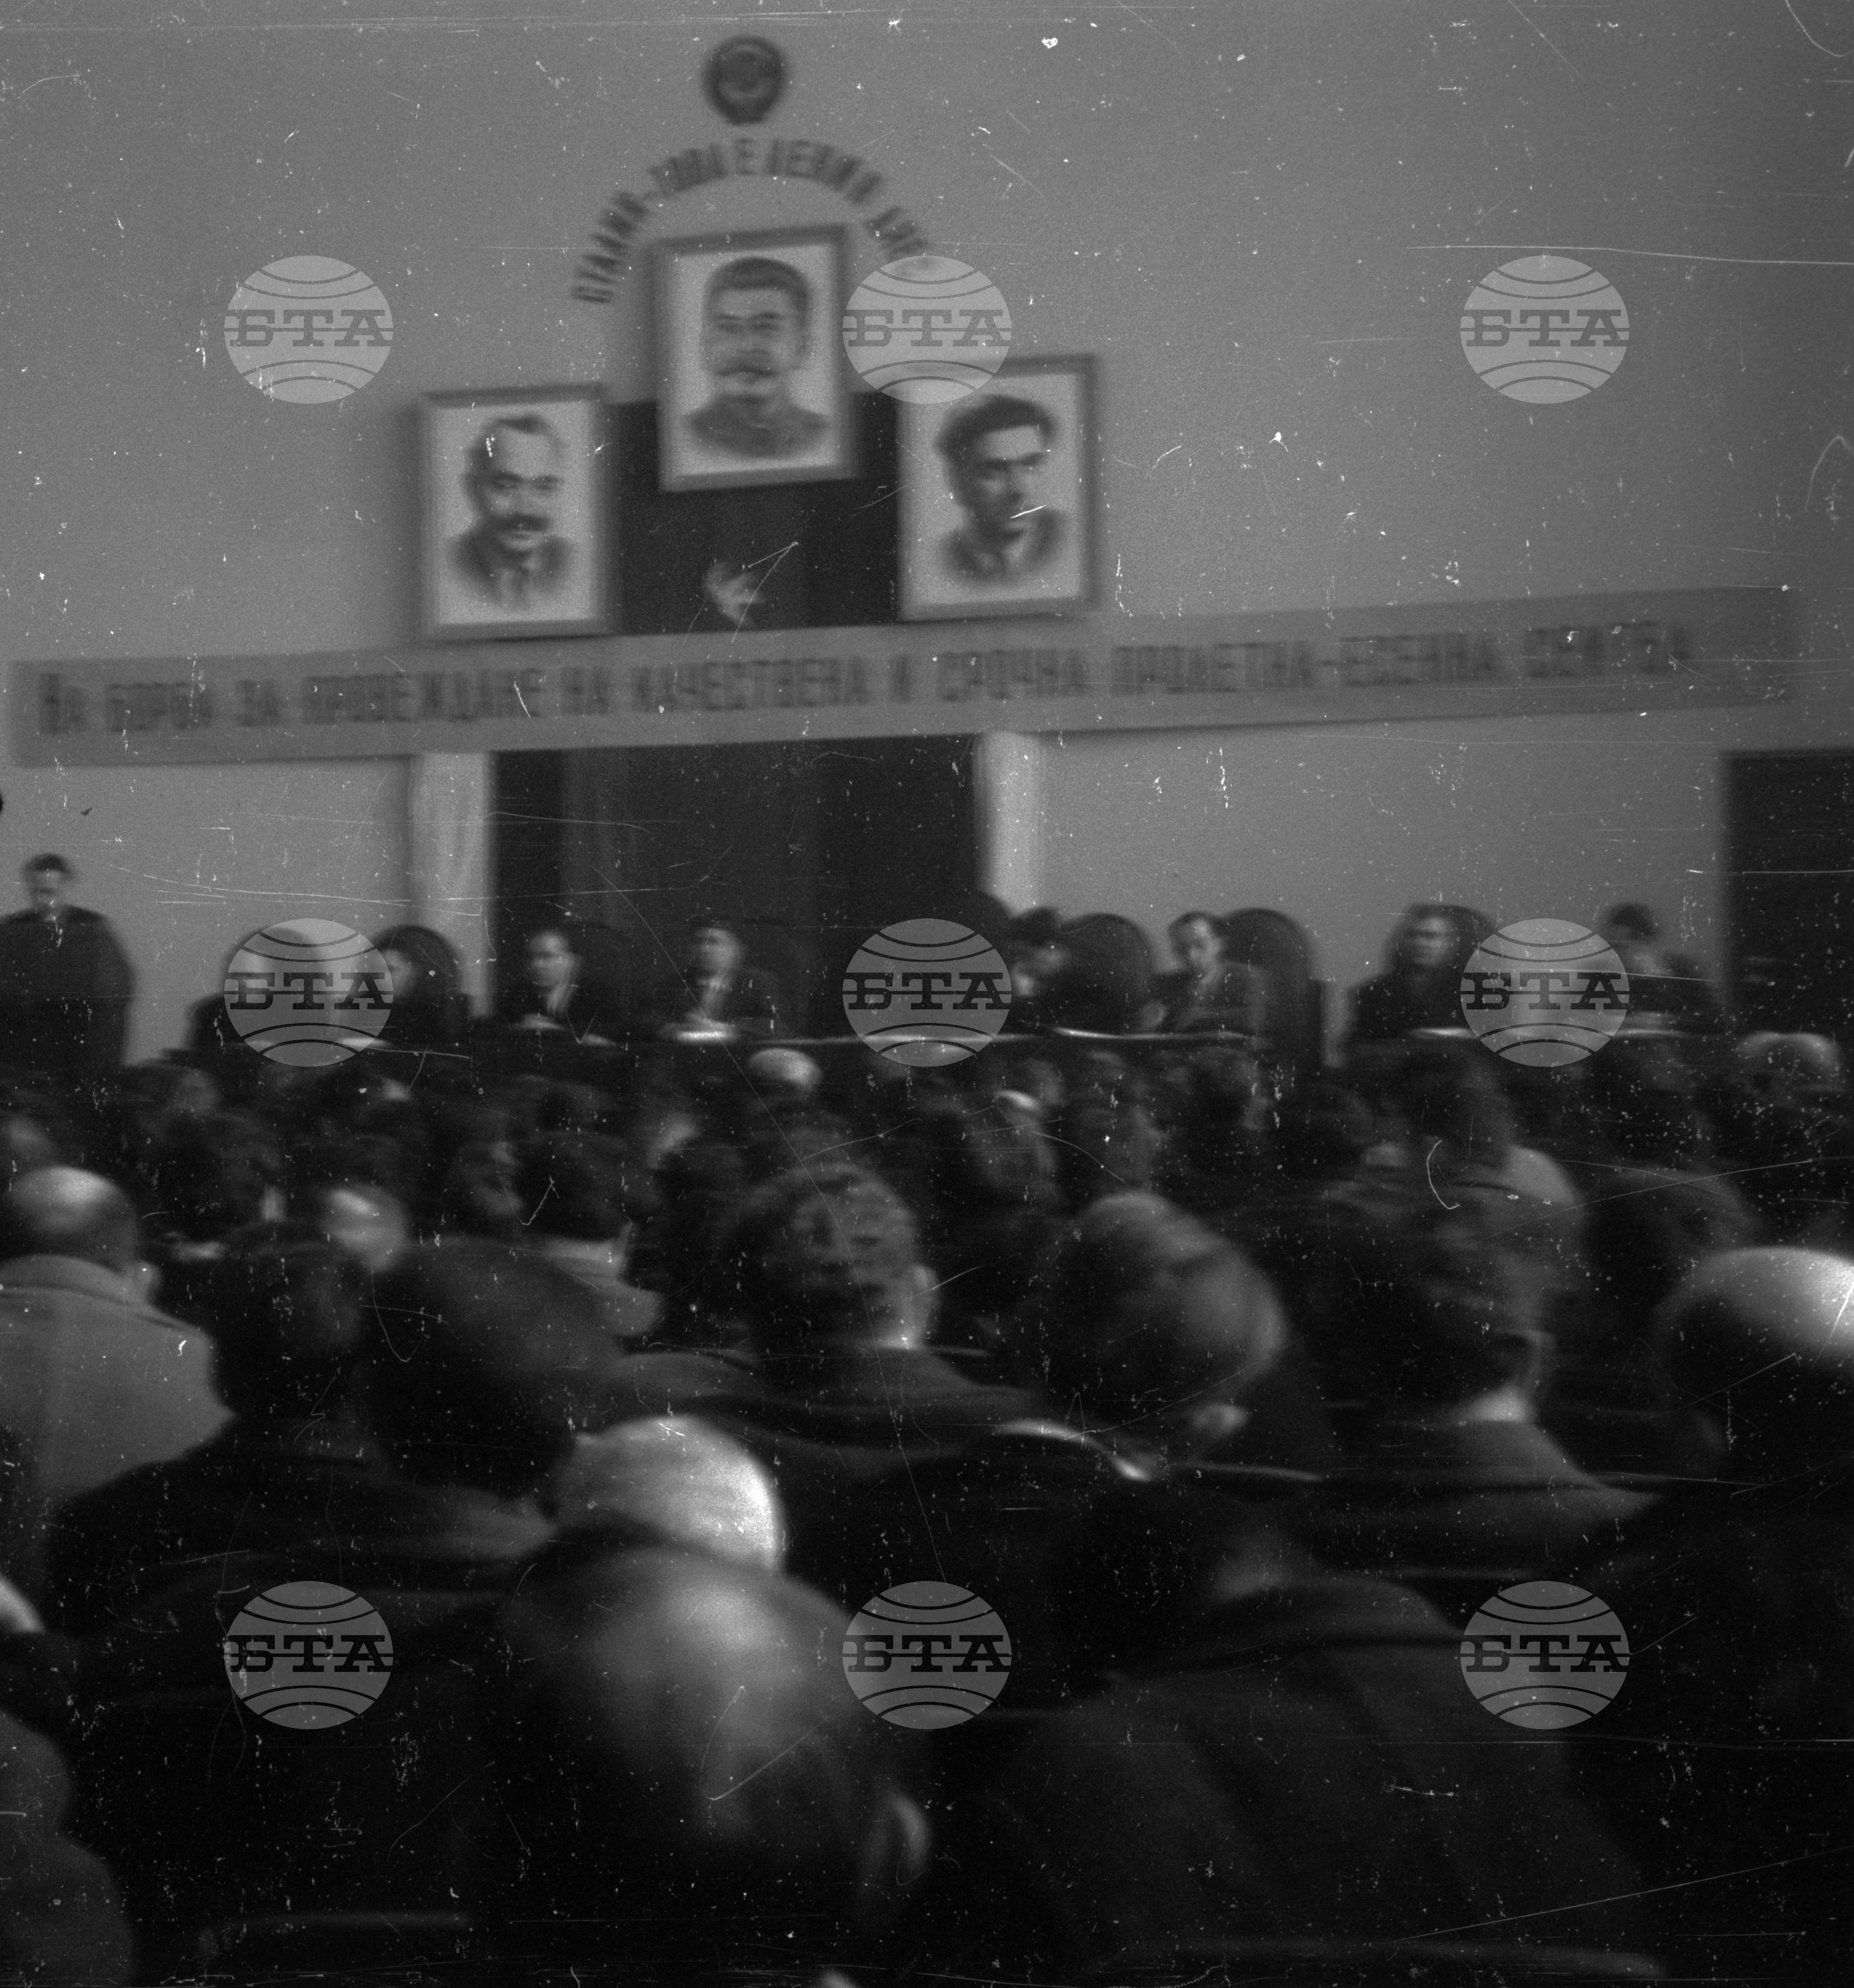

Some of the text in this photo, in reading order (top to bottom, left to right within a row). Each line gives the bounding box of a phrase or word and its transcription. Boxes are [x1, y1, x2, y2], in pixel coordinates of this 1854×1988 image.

[235, 678, 283, 729] ЗА
[561, 666, 608, 716] НА
[631, 655, 868, 713] КАЧЕСТВЕНА
